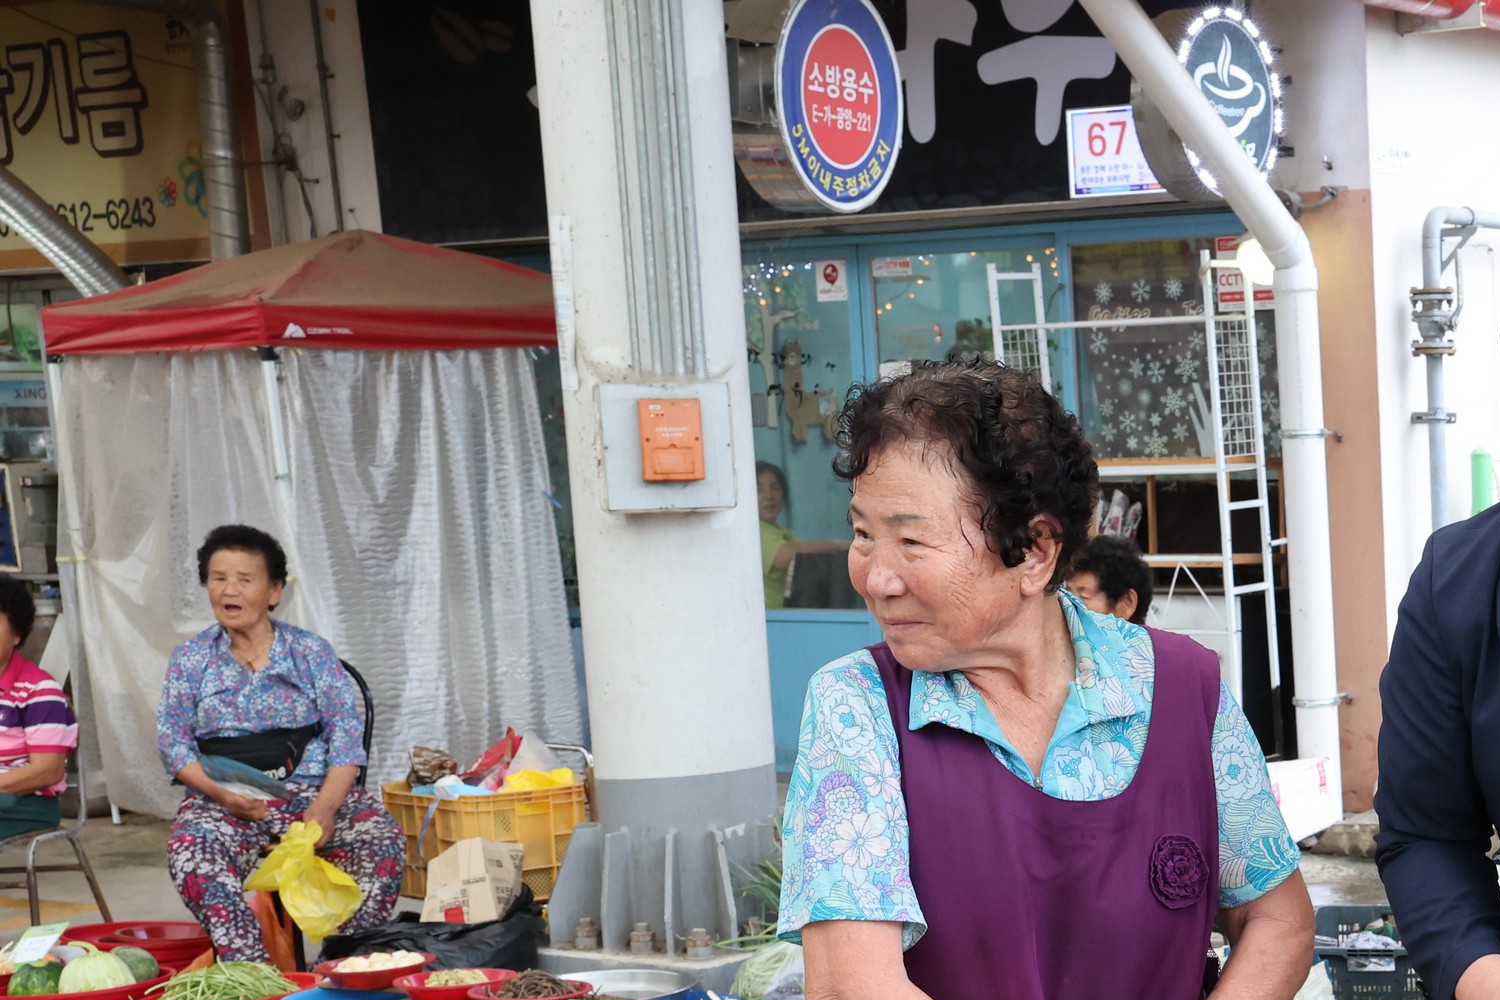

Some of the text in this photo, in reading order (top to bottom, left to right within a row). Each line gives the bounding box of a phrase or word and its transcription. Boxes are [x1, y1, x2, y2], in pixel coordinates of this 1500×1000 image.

[807, 62, 875, 105] 소방용수
[811, 103, 872, 132] E-가-광양-221
[1087, 120, 1127, 157] 67
